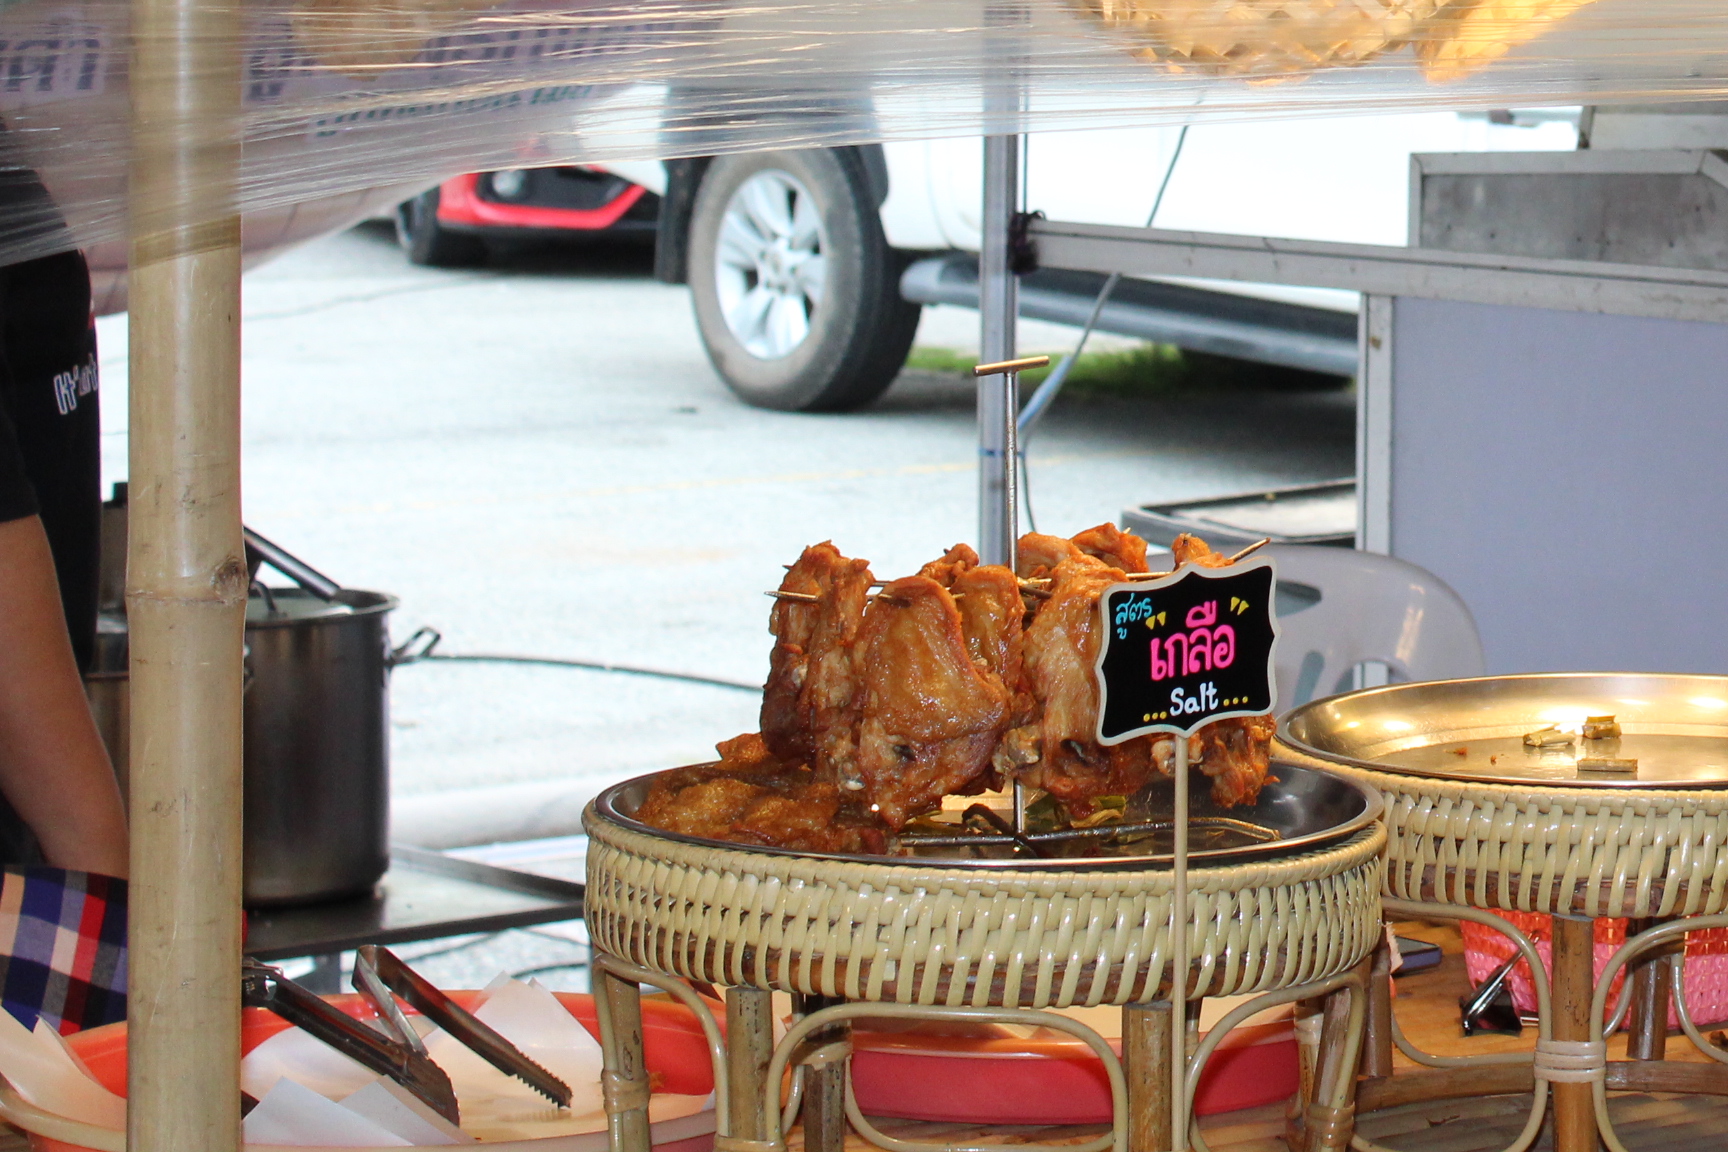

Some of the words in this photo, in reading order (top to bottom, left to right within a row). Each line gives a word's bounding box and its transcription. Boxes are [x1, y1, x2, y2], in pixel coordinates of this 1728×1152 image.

[1114, 591, 1154, 641] สูตร
[1149, 599, 1237, 682] เกลือ
[1169, 680, 1219, 718] Salt
